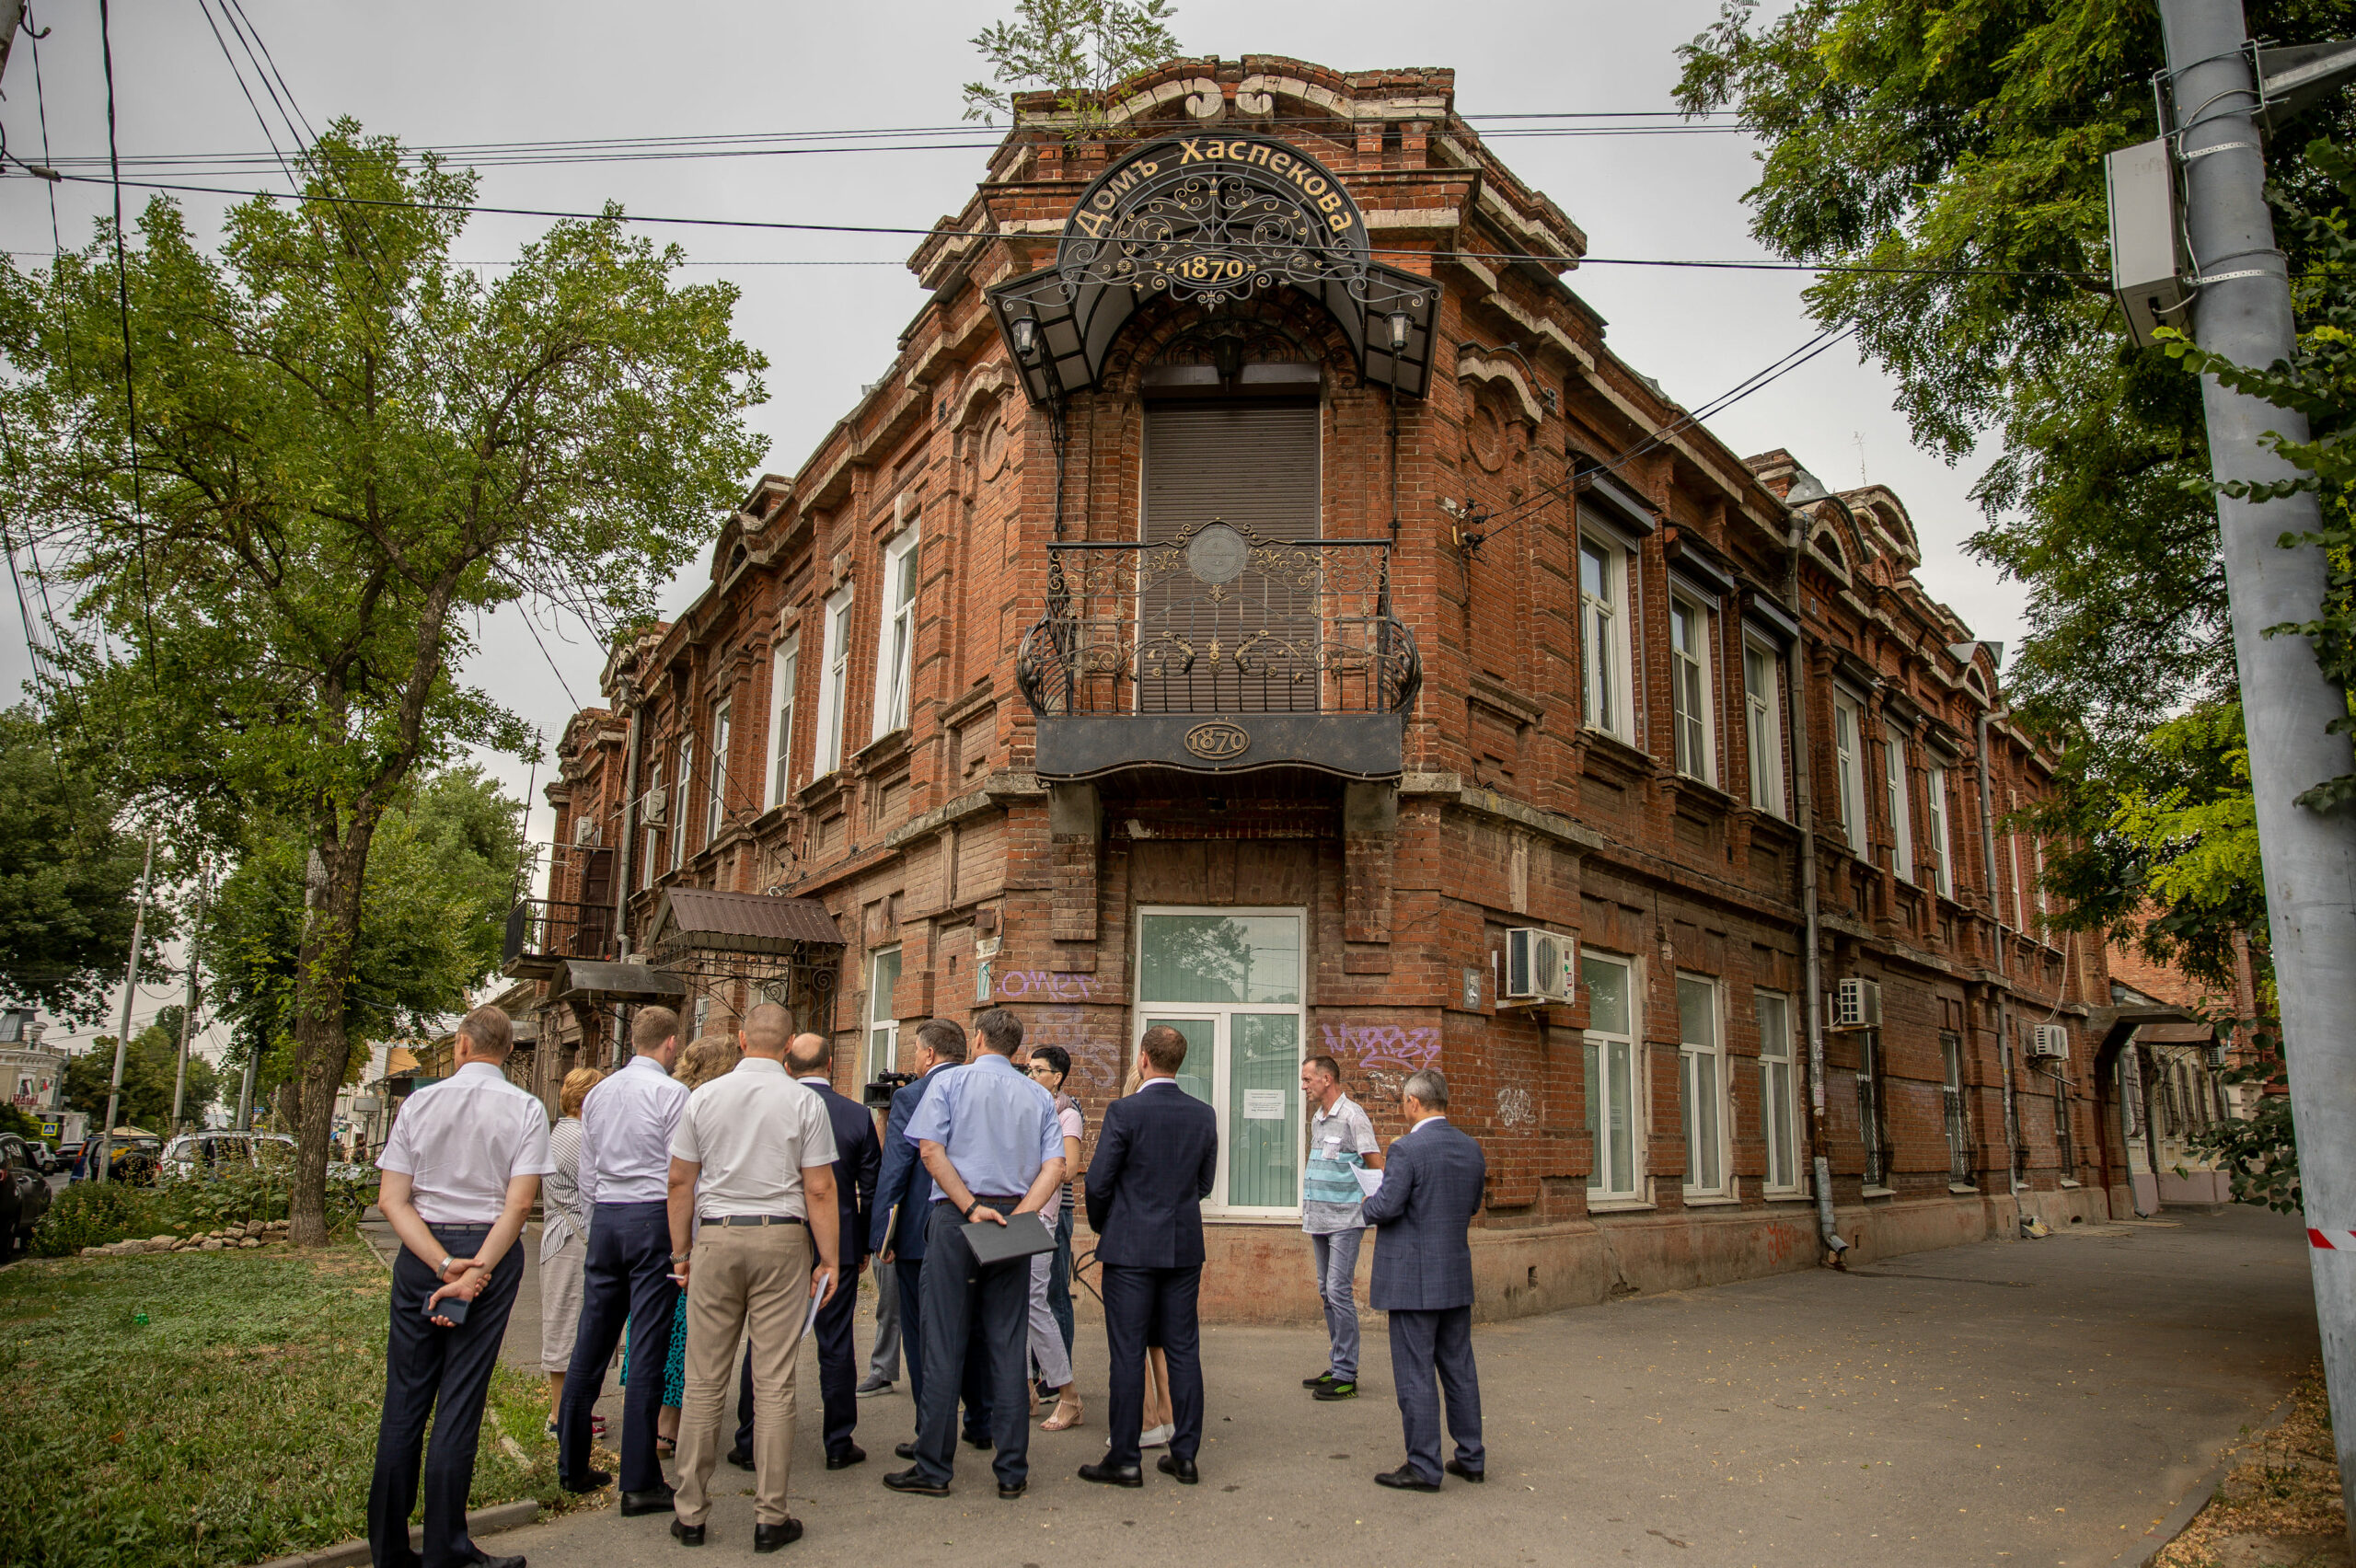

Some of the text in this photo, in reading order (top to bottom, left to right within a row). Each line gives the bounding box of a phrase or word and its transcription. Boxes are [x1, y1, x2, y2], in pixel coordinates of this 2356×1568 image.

[1075, 137, 1353, 238] Домъ Хаспекова
[1180, 257, 1243, 282] 1870
[1189, 728, 1246, 754] 1870
[13, 1093, 39, 1105] Hotel
